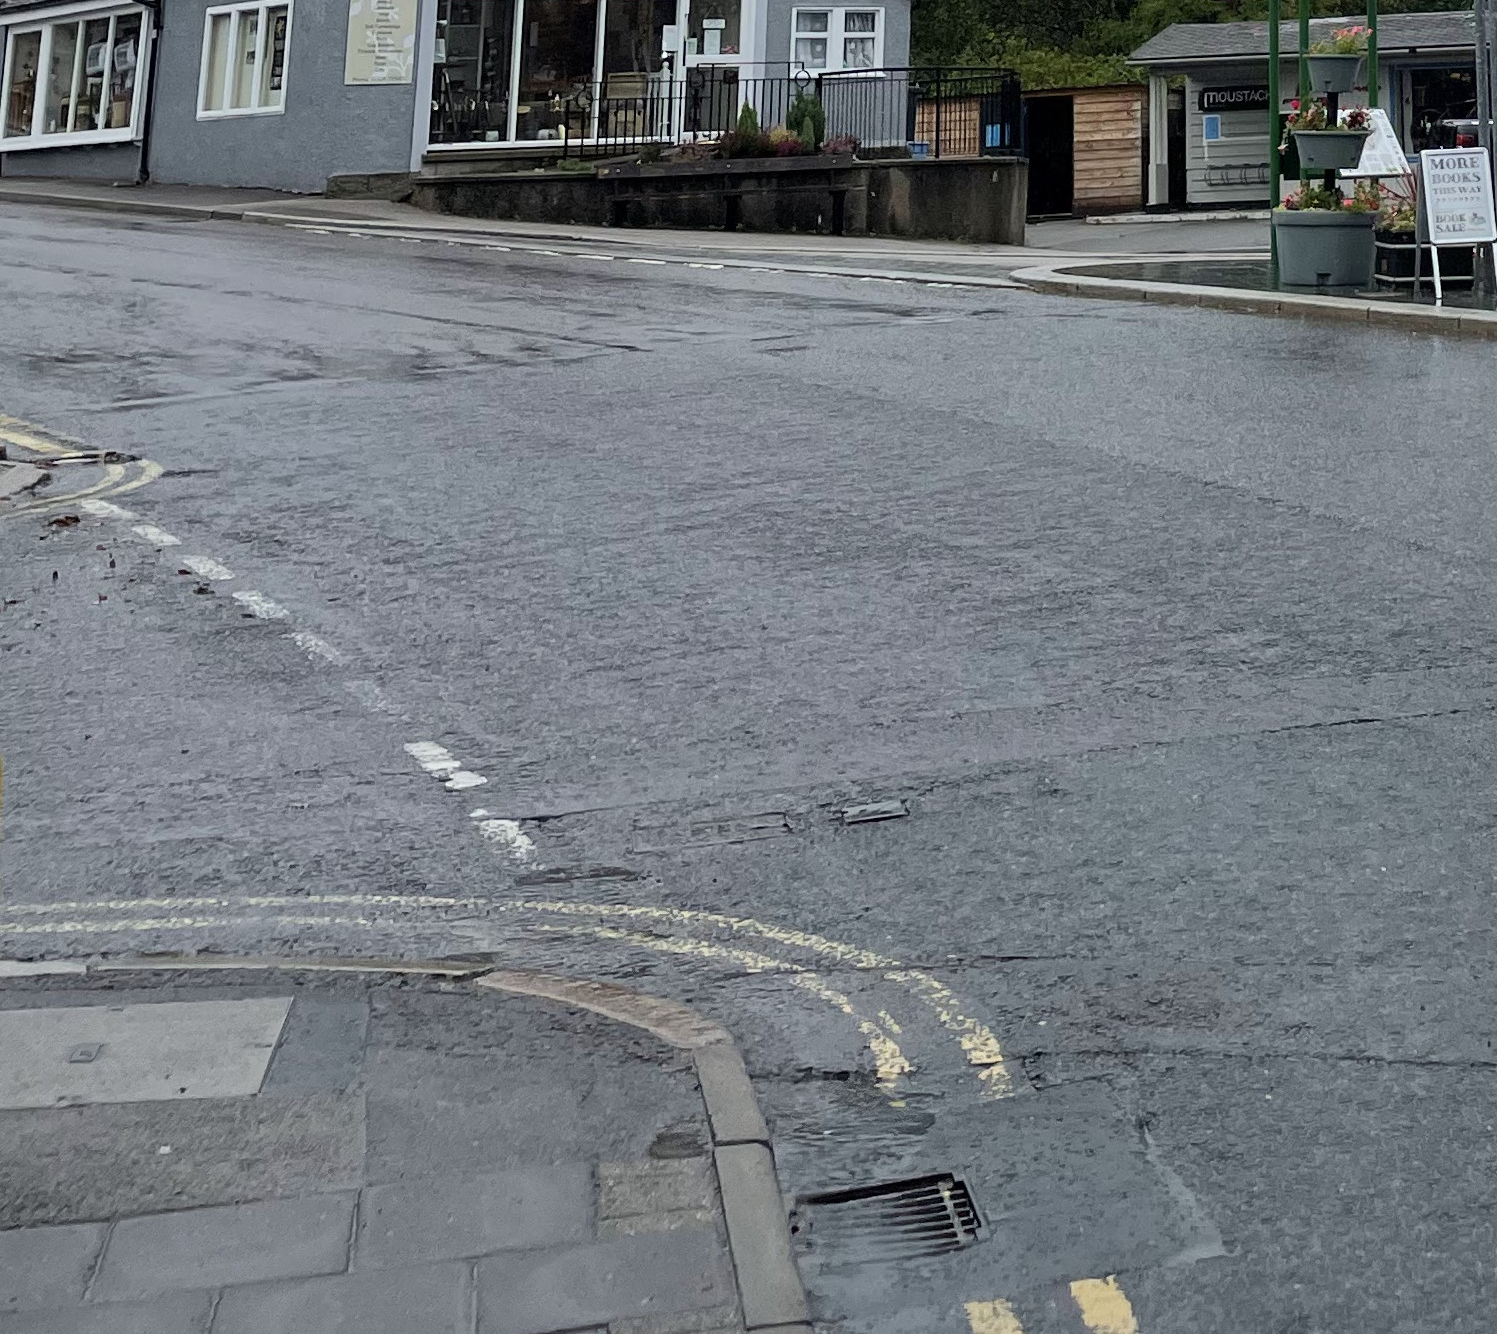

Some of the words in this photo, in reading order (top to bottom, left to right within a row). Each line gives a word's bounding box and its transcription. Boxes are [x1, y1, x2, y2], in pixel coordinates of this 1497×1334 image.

[1430, 156, 1480, 170] MORE
[1431, 172, 1481, 184] BOOKS
[1432, 186, 1457, 195] THIS
[1458, 185, 1482, 194] WAY
[1435, 213, 1466, 223] BOOK
[1435, 222, 1466, 233] SALE
